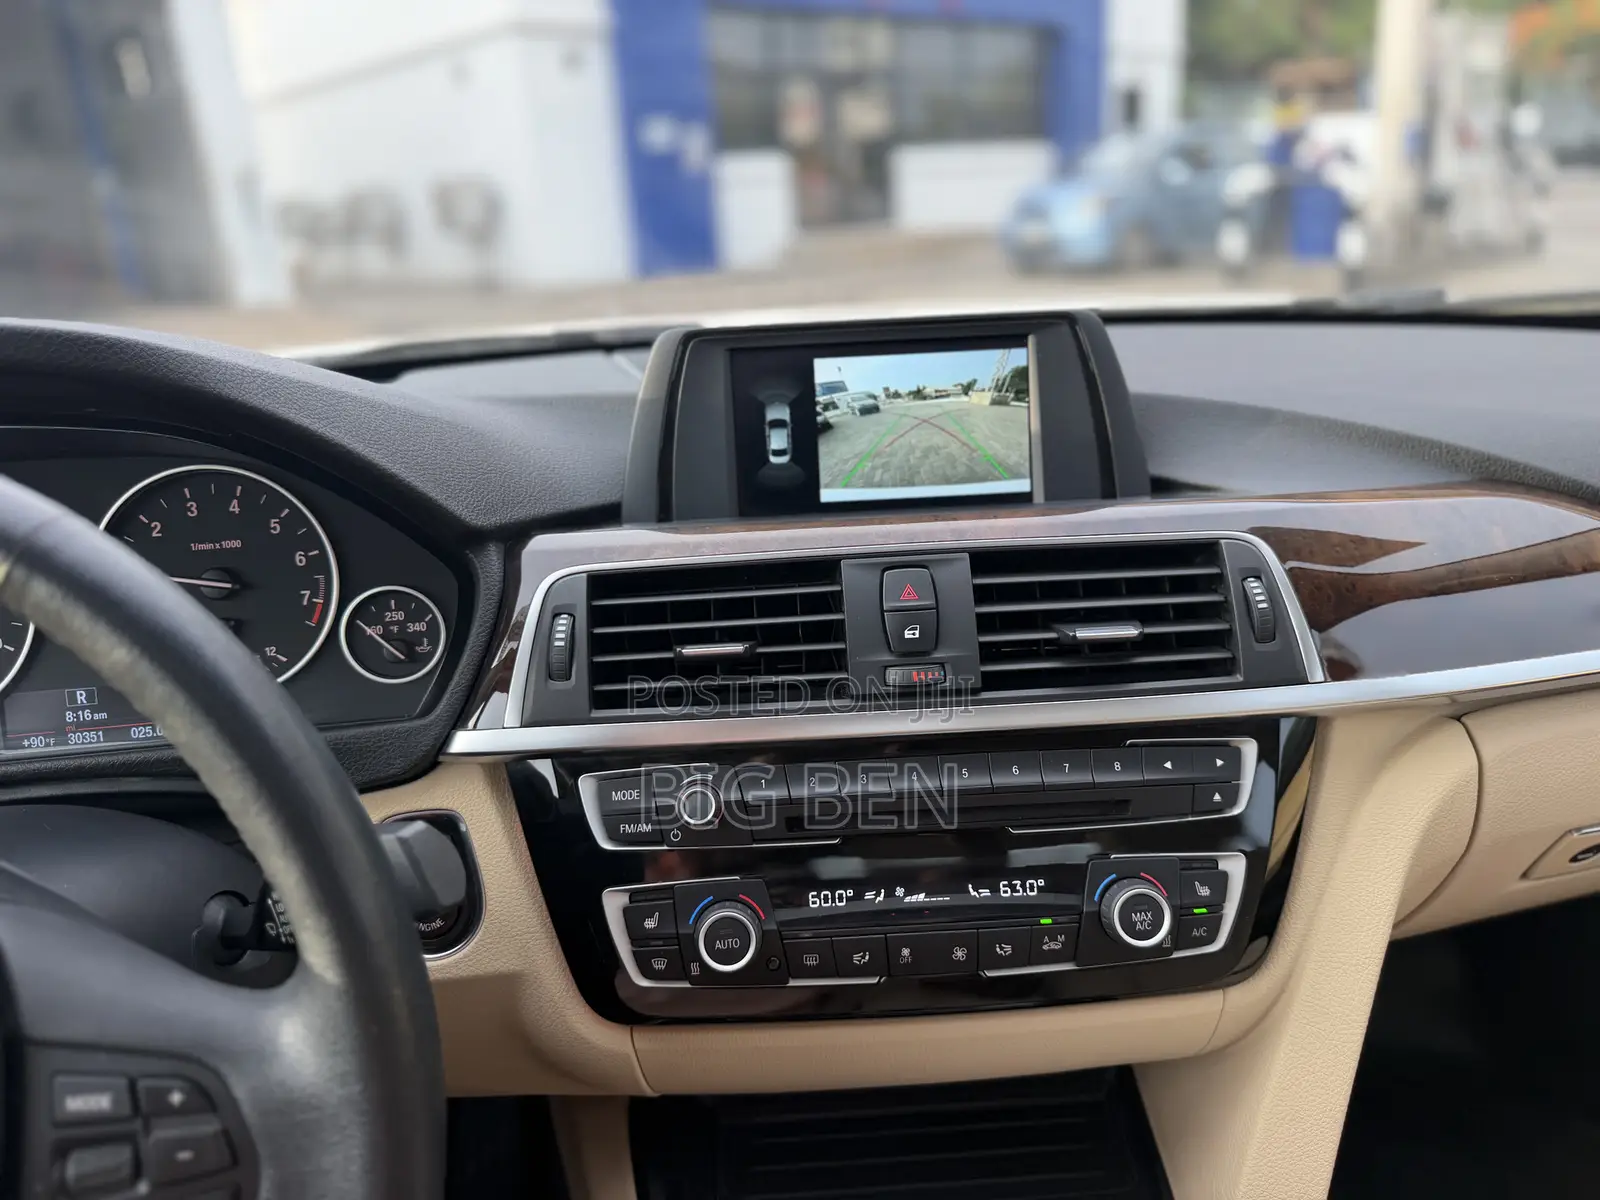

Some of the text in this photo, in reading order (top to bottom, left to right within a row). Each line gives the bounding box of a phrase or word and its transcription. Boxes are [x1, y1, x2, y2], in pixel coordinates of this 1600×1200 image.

[186, 501, 198, 517] 3
[229, 499, 240, 514] 4
[150, 521, 162, 537] 2
[269, 518, 281, 534] 5
[221, 539, 242, 549] 1000
[295, 551, 306, 566] 6
[300, 590, 311, 605] 7
[384, 611, 405, 622] 250
[406, 621, 427, 633] 340
[264, 646, 277, 656] 12
[76, 690, 88, 704] R
[68, 731, 104, 745] 30351
[1011, 765, 1020, 776] 6
[1062, 763, 1071, 774] 7
[1113, 761, 1122, 772] 8
[860, 774, 868, 785] 3
[961, 768, 969, 780] 5
[760, 779, 766, 789] 1
[809, 776, 817, 788] 2
[612, 789, 640, 802] MODE
[620, 823, 652, 835] FM/AM
[1131, 911, 1153, 923] MAX
[414, 917, 446, 932] NGINE
[1135, 921, 1152, 931] A/C
[1191, 926, 1207, 938] A/C
[715, 938, 740, 950] AUTO
[899, 955, 913, 965] OFF
